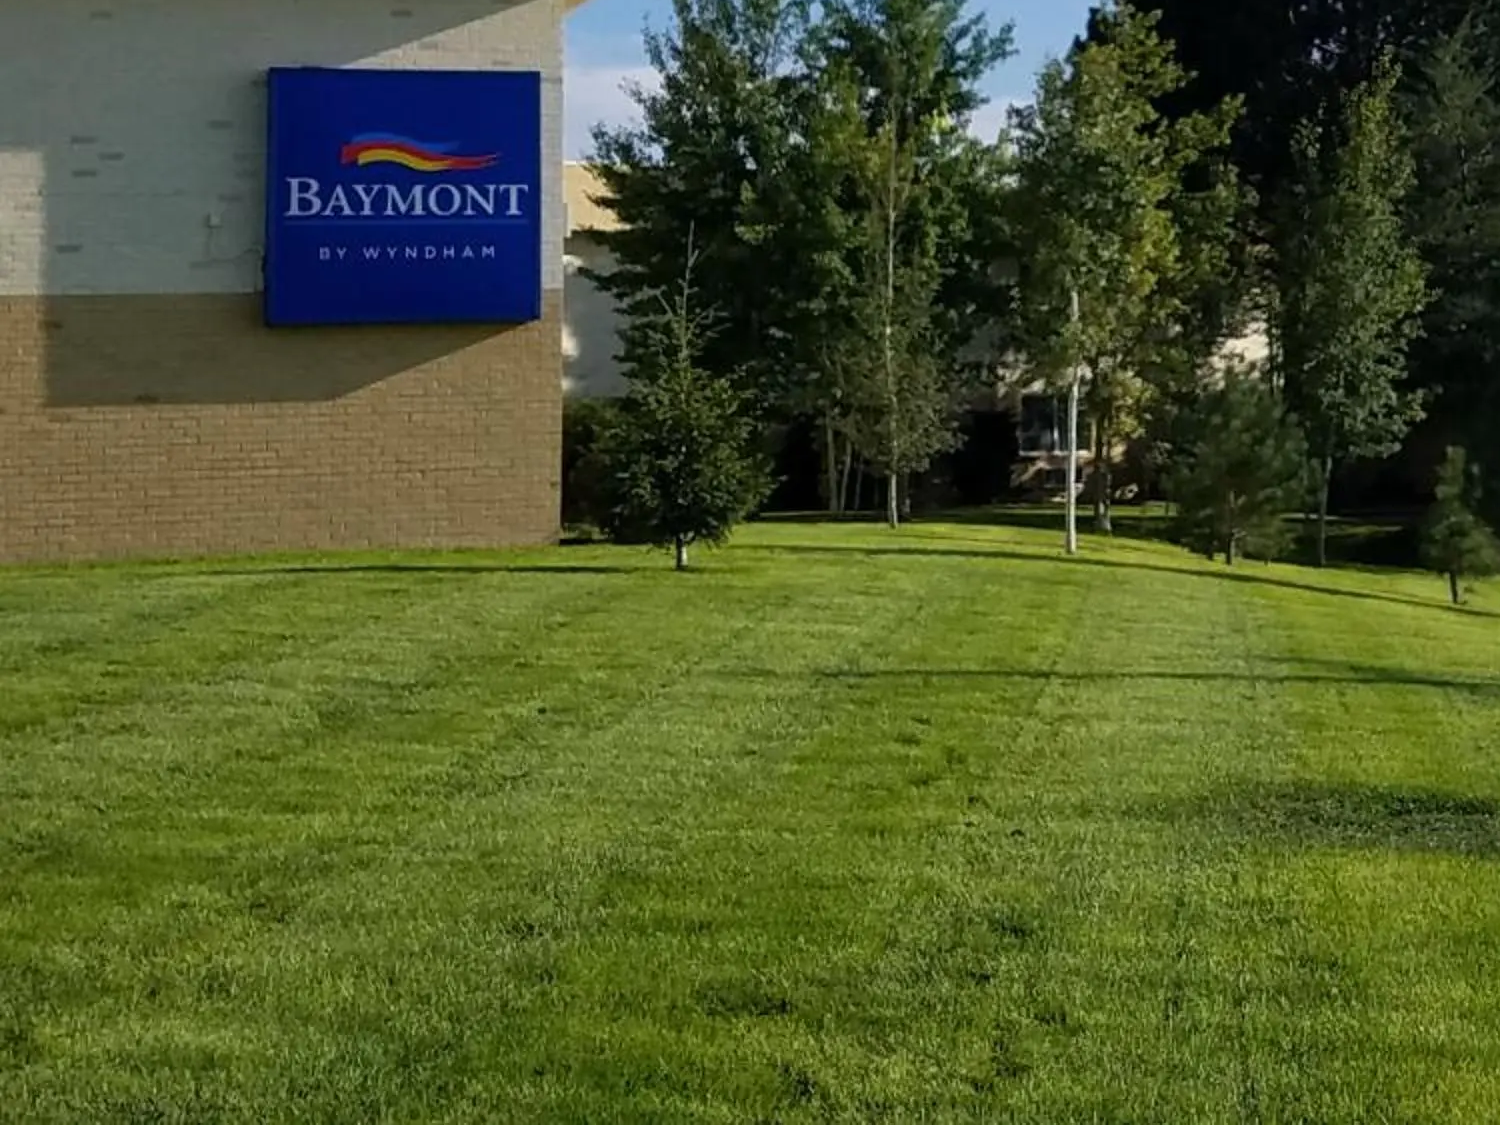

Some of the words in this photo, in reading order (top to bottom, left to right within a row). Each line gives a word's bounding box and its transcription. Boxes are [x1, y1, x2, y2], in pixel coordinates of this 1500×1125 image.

[284, 176, 529, 216] BAYMONT
[319, 246, 347, 260] BY
[362, 245, 495, 260] WYNDHAM
